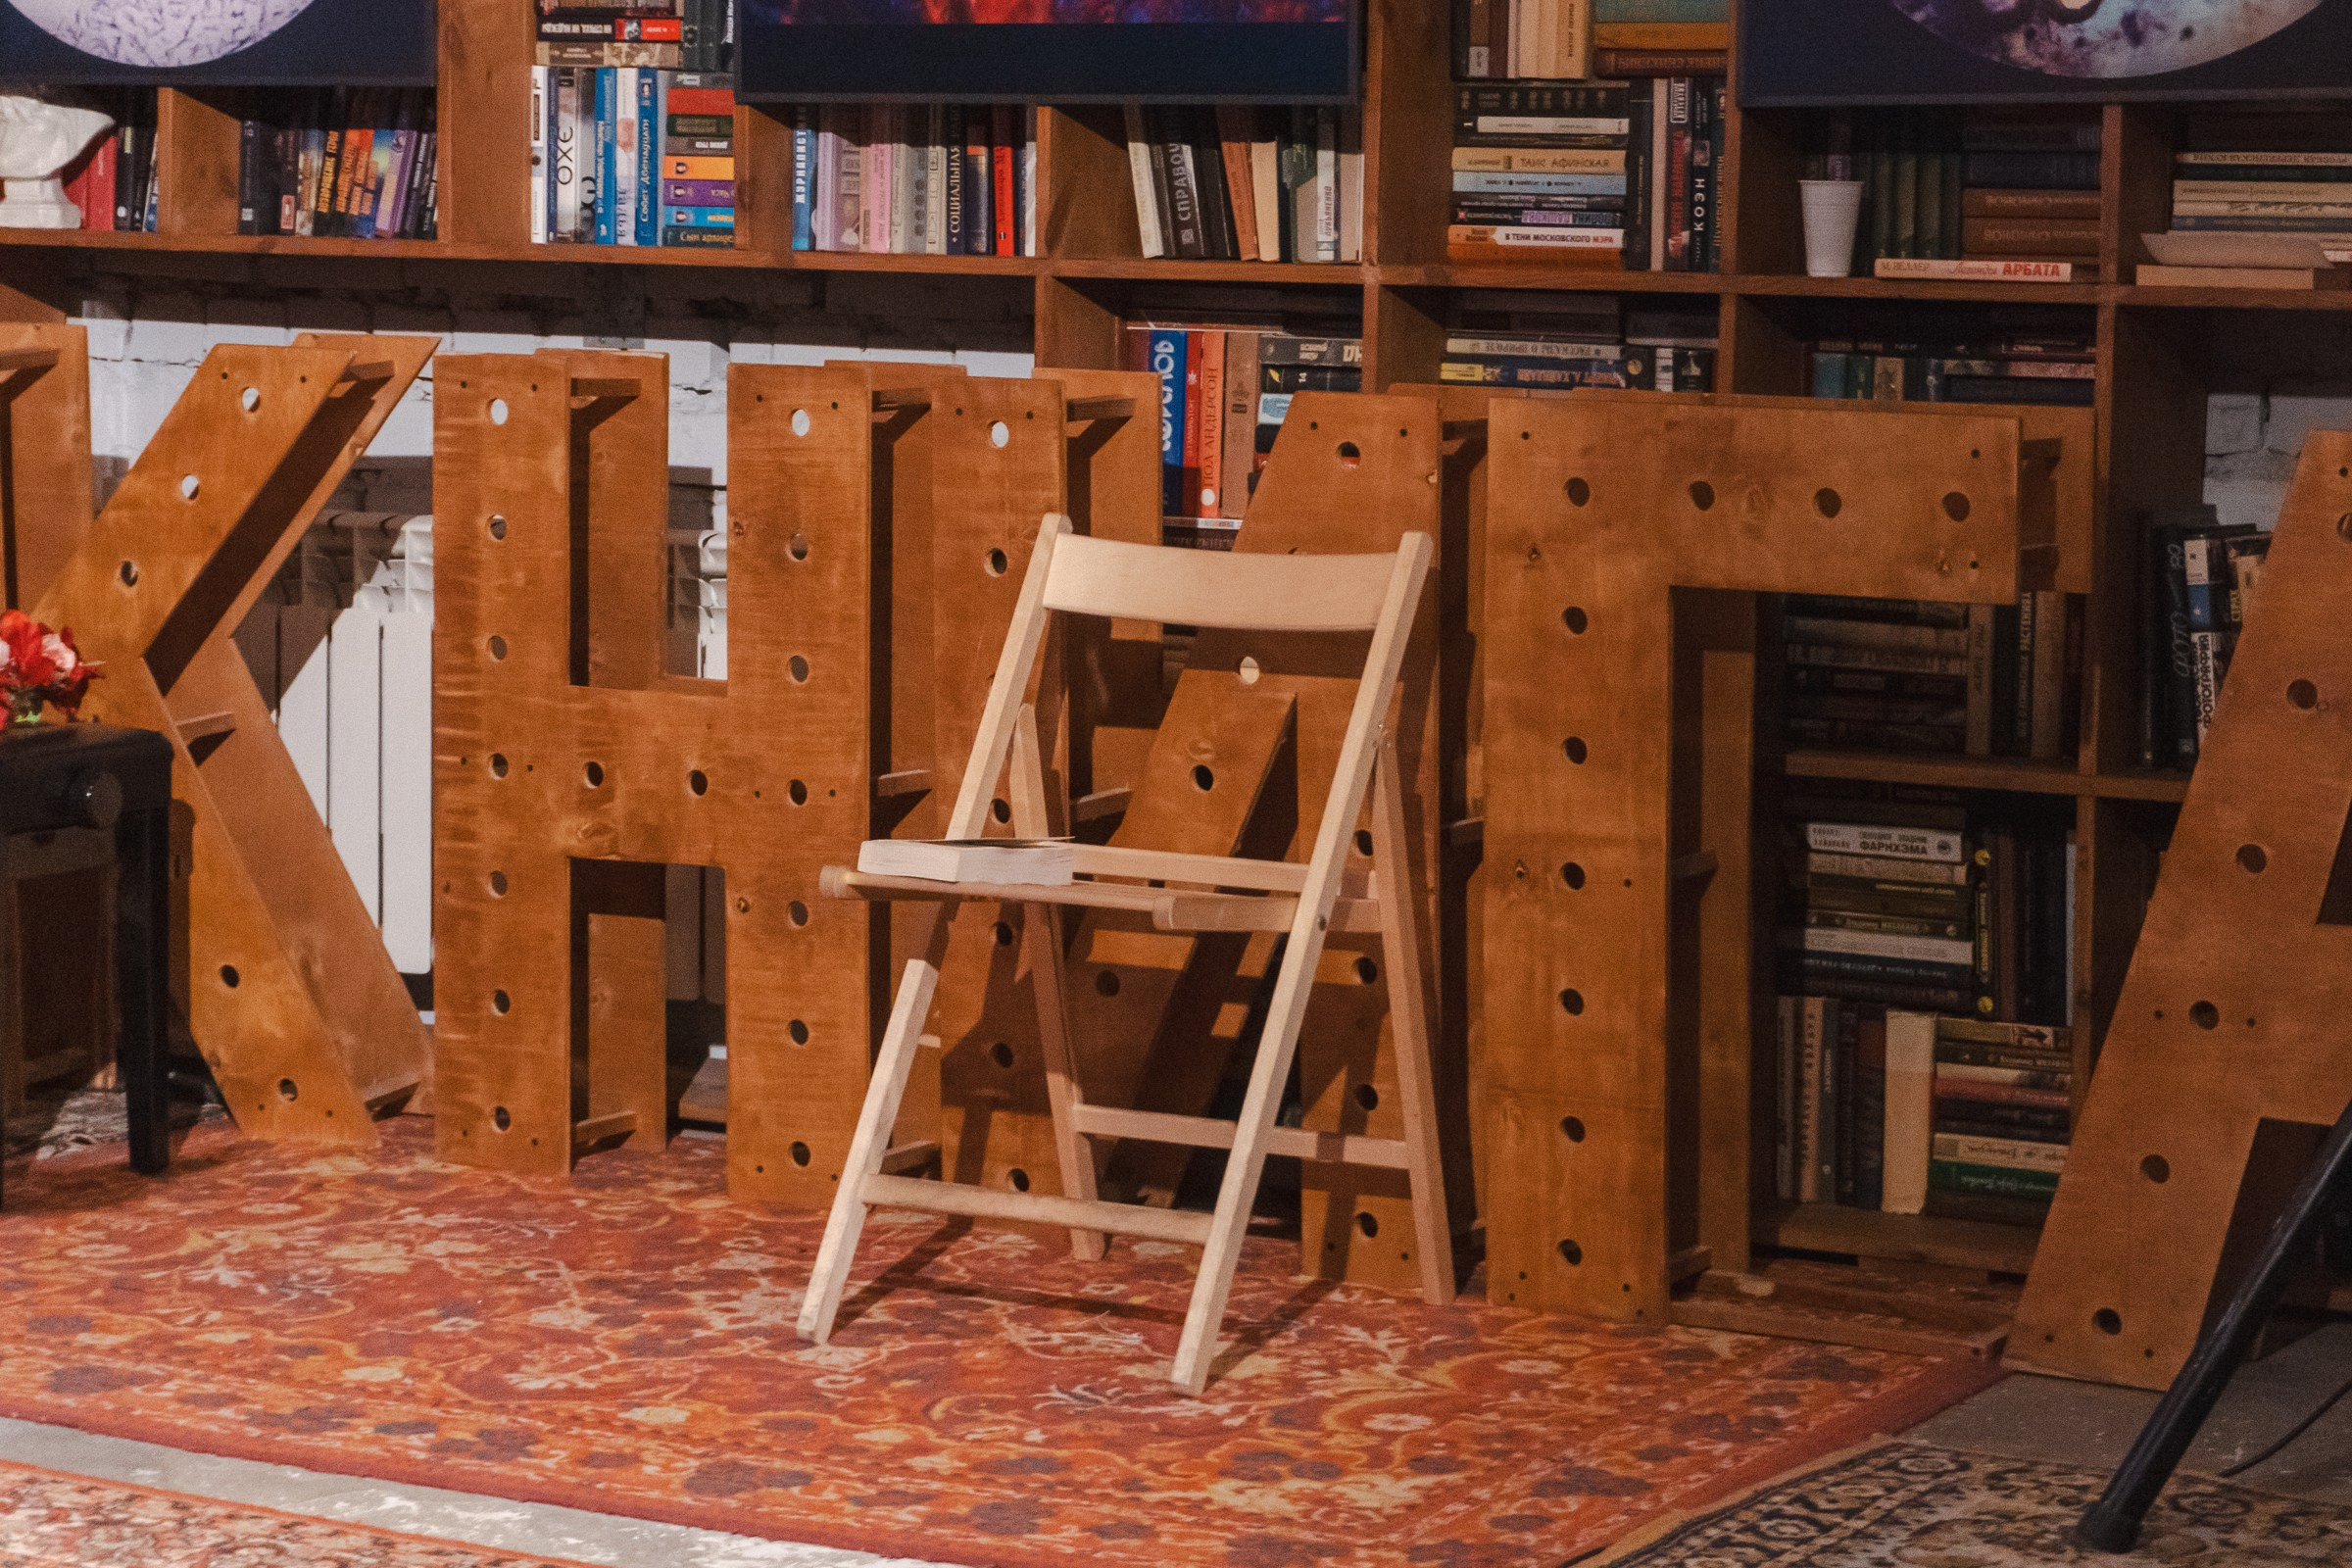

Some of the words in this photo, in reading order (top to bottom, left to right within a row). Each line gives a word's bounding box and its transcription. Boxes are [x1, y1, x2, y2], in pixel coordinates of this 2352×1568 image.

[557, 125, 573, 185] ЭХО
[640, 118, 652, 184] Двенадцати
[1520, 158, 1545, 169] ТАИС
[1551, 158, 1610, 169] АФИНСКАЯ
[640, 186, 649, 222] Совет
[949, 146, 961, 233] СОЦИАЛЬНАЯ
[1169, 142, 1192, 221] СПРАВОЧ
[1693, 177, 1705, 231] КОЭН
[1324, 185, 1333, 237] ЛУКЬЯНЕНКО
[1511, 232, 1531, 242] ТЕНИ
[1532, 233, 1591, 244] МОСКОВСКОГО
[1592, 235, 1614, 245] МЭРА
[2002, 263, 2061, 276] АРБАТА
[1204, 368, 1218, 449] АНДЕРСОН
[1202, 455, 1214, 488] ПОЛ
[2198, 633, 2214, 728] ФОТОГРАФИЯ
[1859, 840, 1929, 856] ФАРНХЭМА
